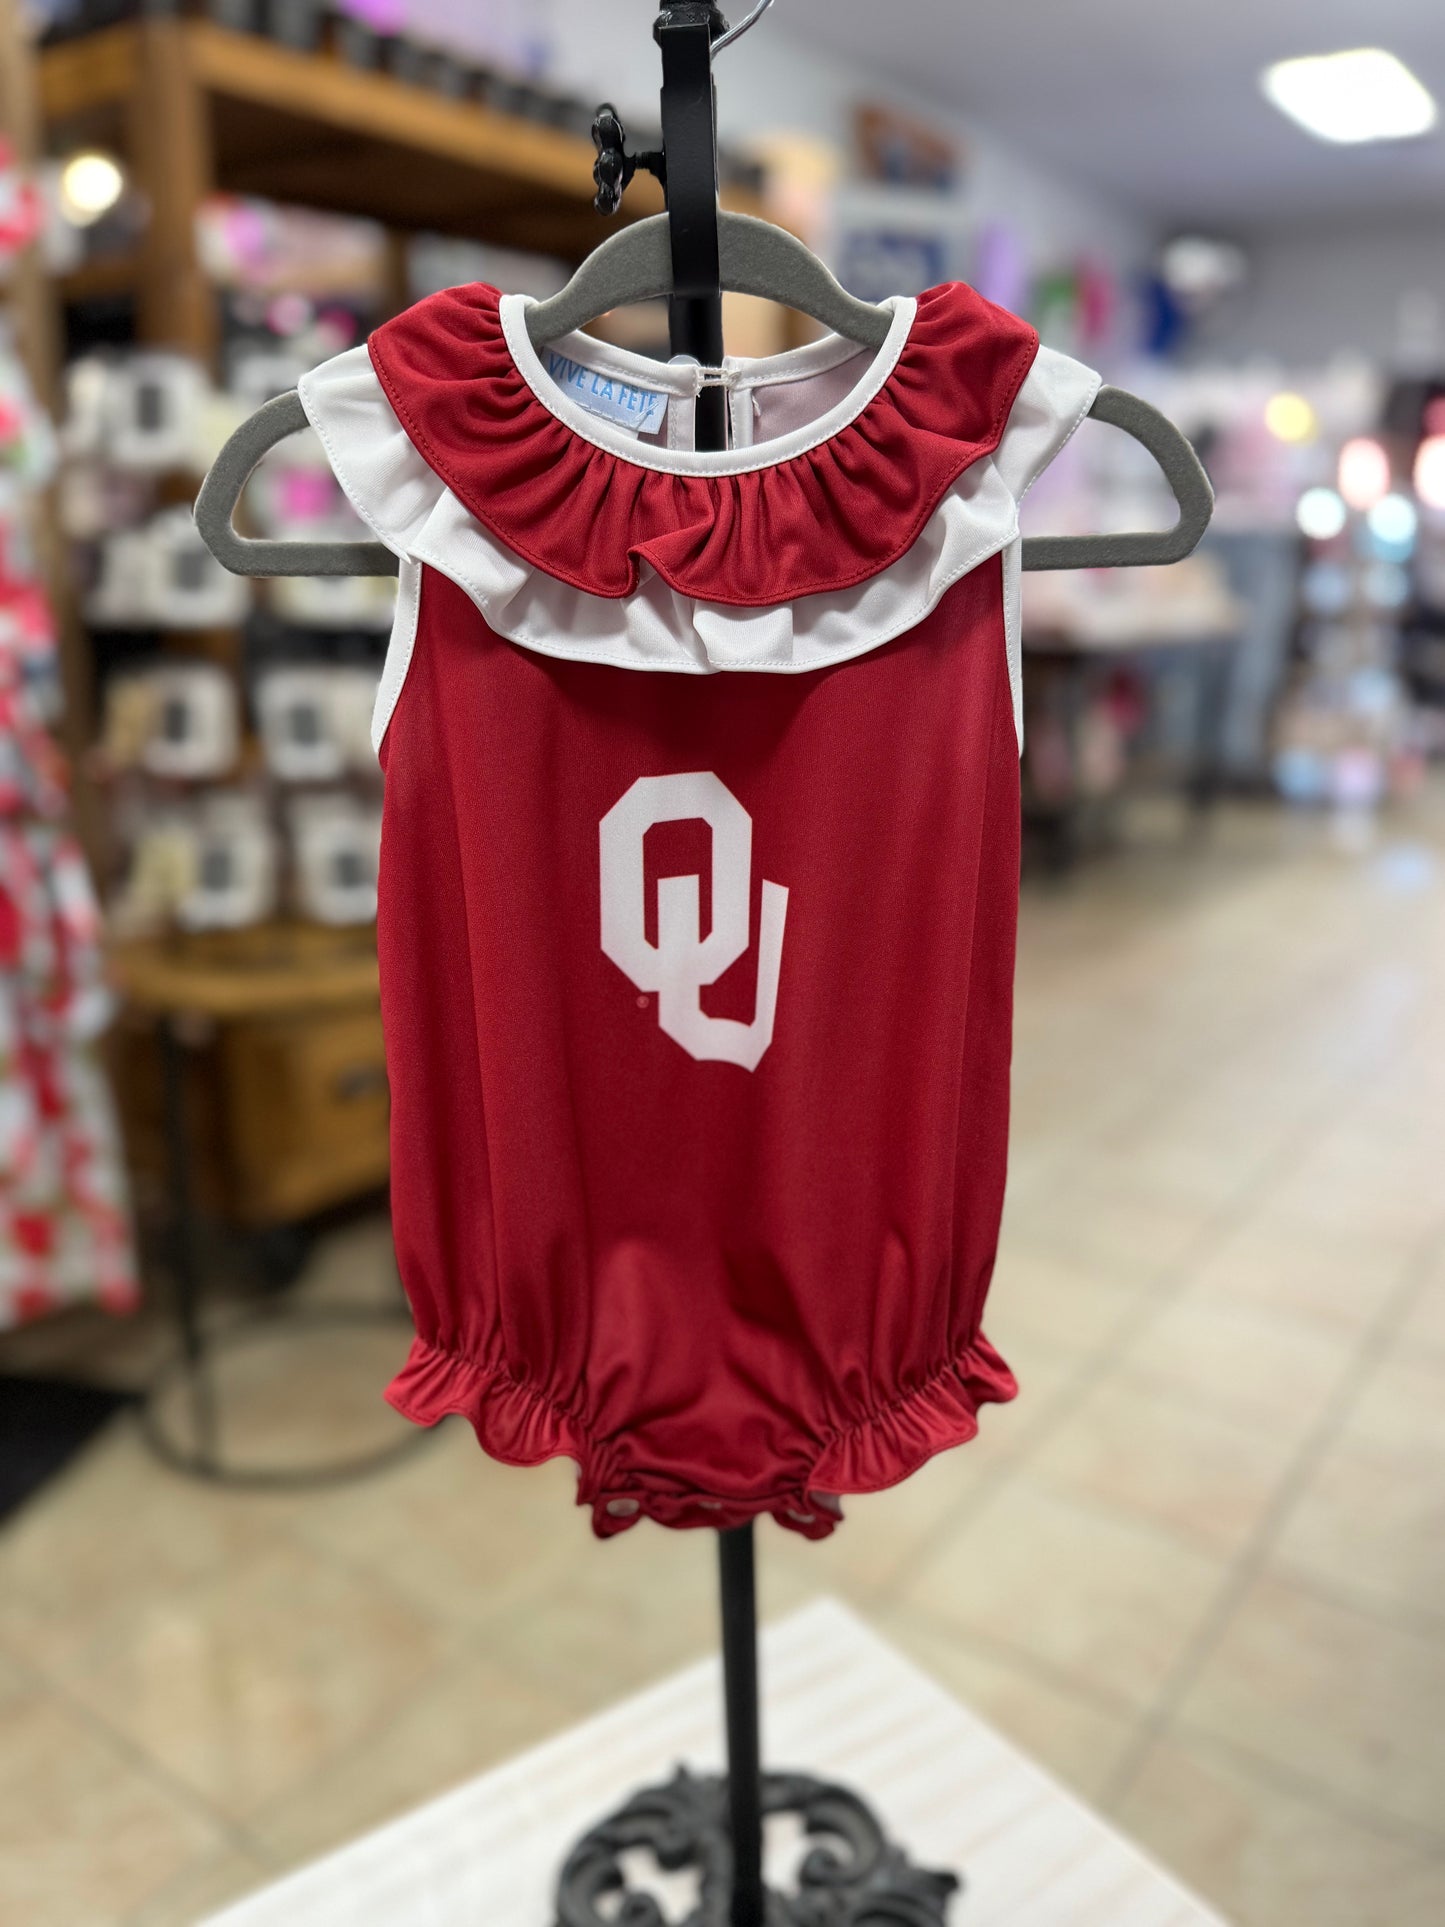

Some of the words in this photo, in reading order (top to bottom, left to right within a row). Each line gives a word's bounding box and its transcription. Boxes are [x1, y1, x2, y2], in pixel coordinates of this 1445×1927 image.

[549, 350, 589, 389] VIVE
[591, 373, 613, 401] LA
[599, 771, 790, 1073] OU
